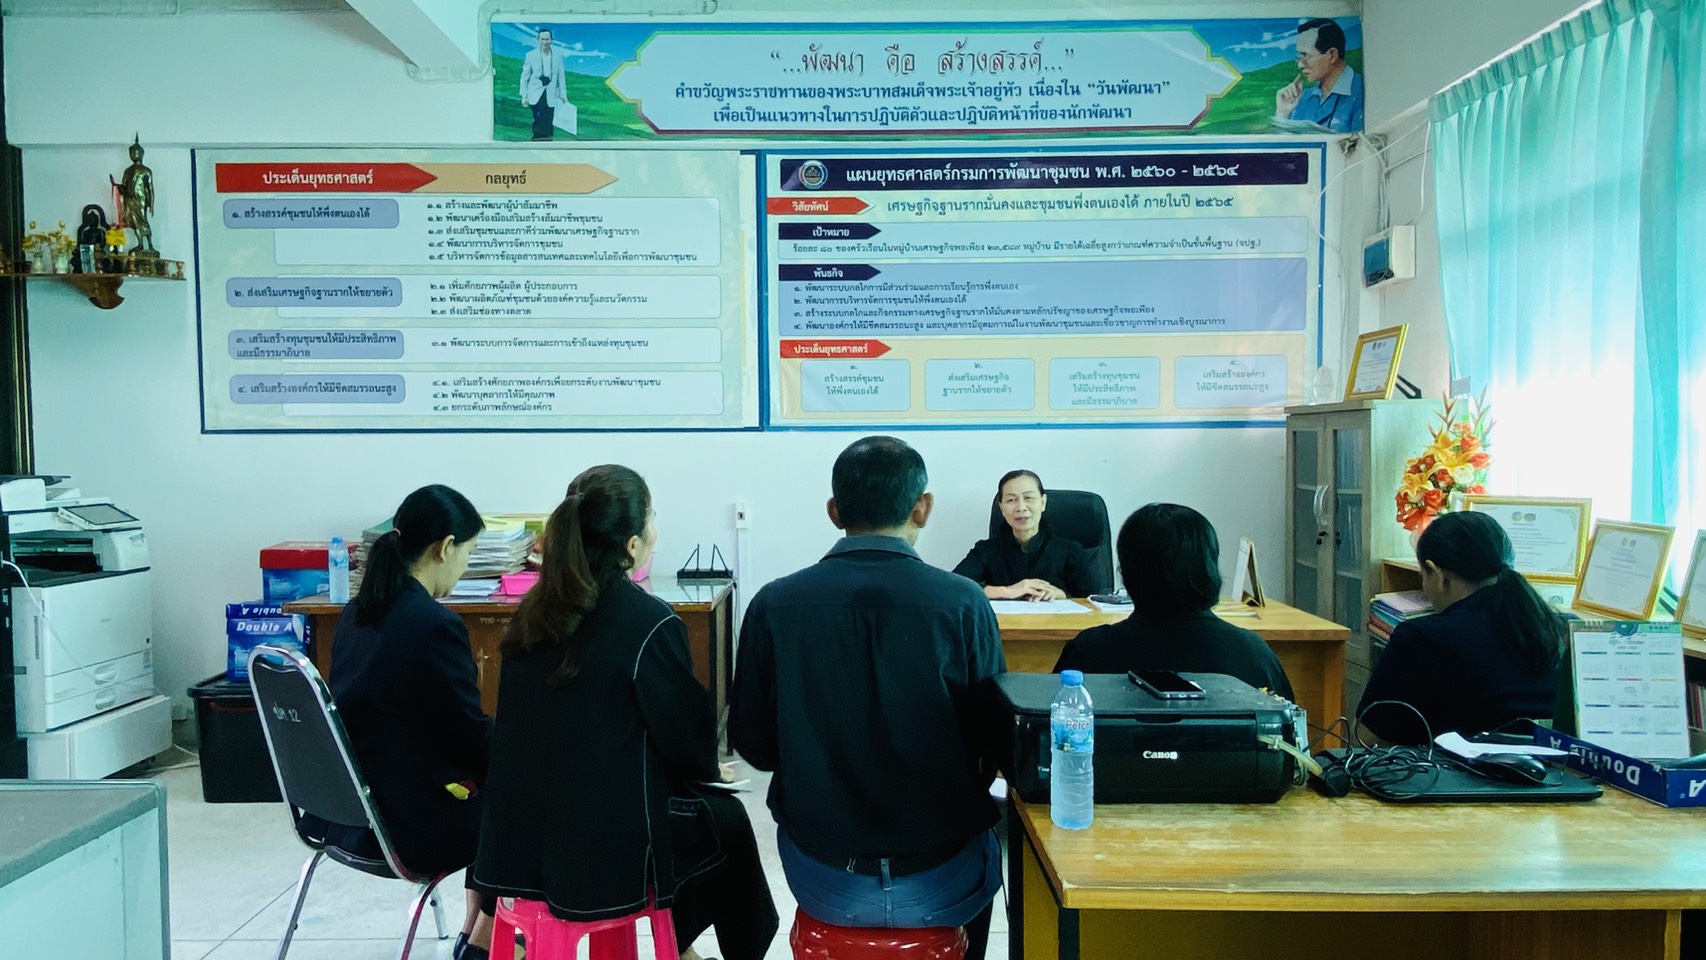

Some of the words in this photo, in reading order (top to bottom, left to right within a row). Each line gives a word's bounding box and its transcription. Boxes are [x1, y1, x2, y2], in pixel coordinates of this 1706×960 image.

[885, 43, 917, 76] คือ
[675, 80, 1022, 102] คำขวัญพระราชทานของพระบาทสมเด็จพระเจ้าอยู่หัว
[1028, 76, 1082, 97] เนื่องใน
[262, 168, 374, 189] ประเด็นยุทธศาสตร์
[485, 169, 527, 189] กลยุทธ์
[846, 163, 1090, 187] แผนยุทธศาสตร์กรมการพัฒนาชุมชน
[1095, 165, 1126, 179] พ.ศ.
[1131, 163, 1176, 177] ๒๕๖๐
[1192, 163, 1239, 177] ๒๕๖๔
[792, 200, 829, 213] วิสัยทัศน์
[887, 192, 1140, 216] เศรษฐกิจฐานรากมั่นคงและชุมชนพึ่งตนเองได้
[1143, 192, 1191, 209] ภายในปี
[244, 206, 370, 222] สร้างสรรค์ชุมชนให้พึ่งตนเองได้
[812, 226, 850, 237] เป้าหมาย
[813, 267, 844, 279] พันธกิจ
[524, 280, 578, 293] ผู้ประกอบการ
[794, 342, 868, 357] ประเด็นยุทธศาสตร์
[252, 607, 283, 616] ouble
[236, 621, 280, 632] Double
[283, 622, 292, 632] A
[1142, 750, 1178, 760] Canon
